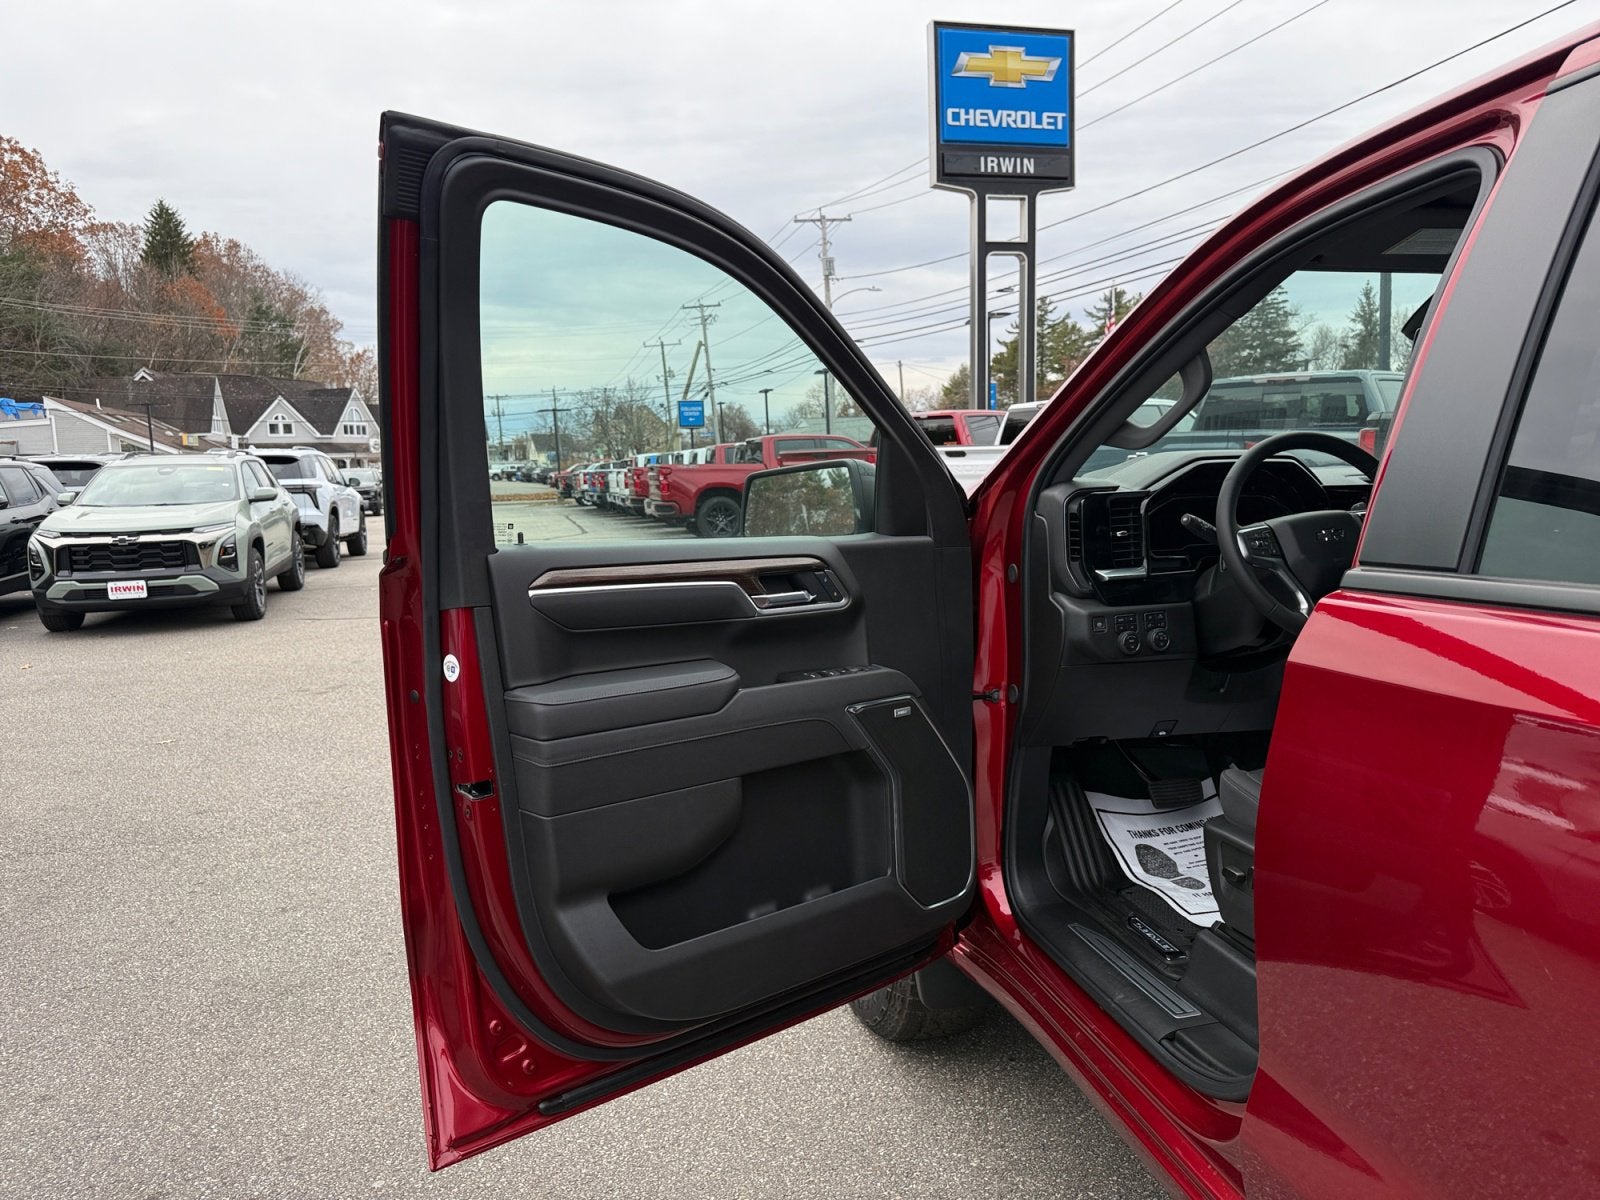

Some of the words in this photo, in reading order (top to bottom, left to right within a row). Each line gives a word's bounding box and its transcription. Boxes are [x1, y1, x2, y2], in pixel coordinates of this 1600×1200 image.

[946, 107, 1066, 130] CHEVROLET
[980, 156, 1035, 174] IRWIN
[110, 585, 144, 593] IRWIN
[1126, 829, 1160, 839] THANKS
[1158, 826, 1177, 836] FOR
